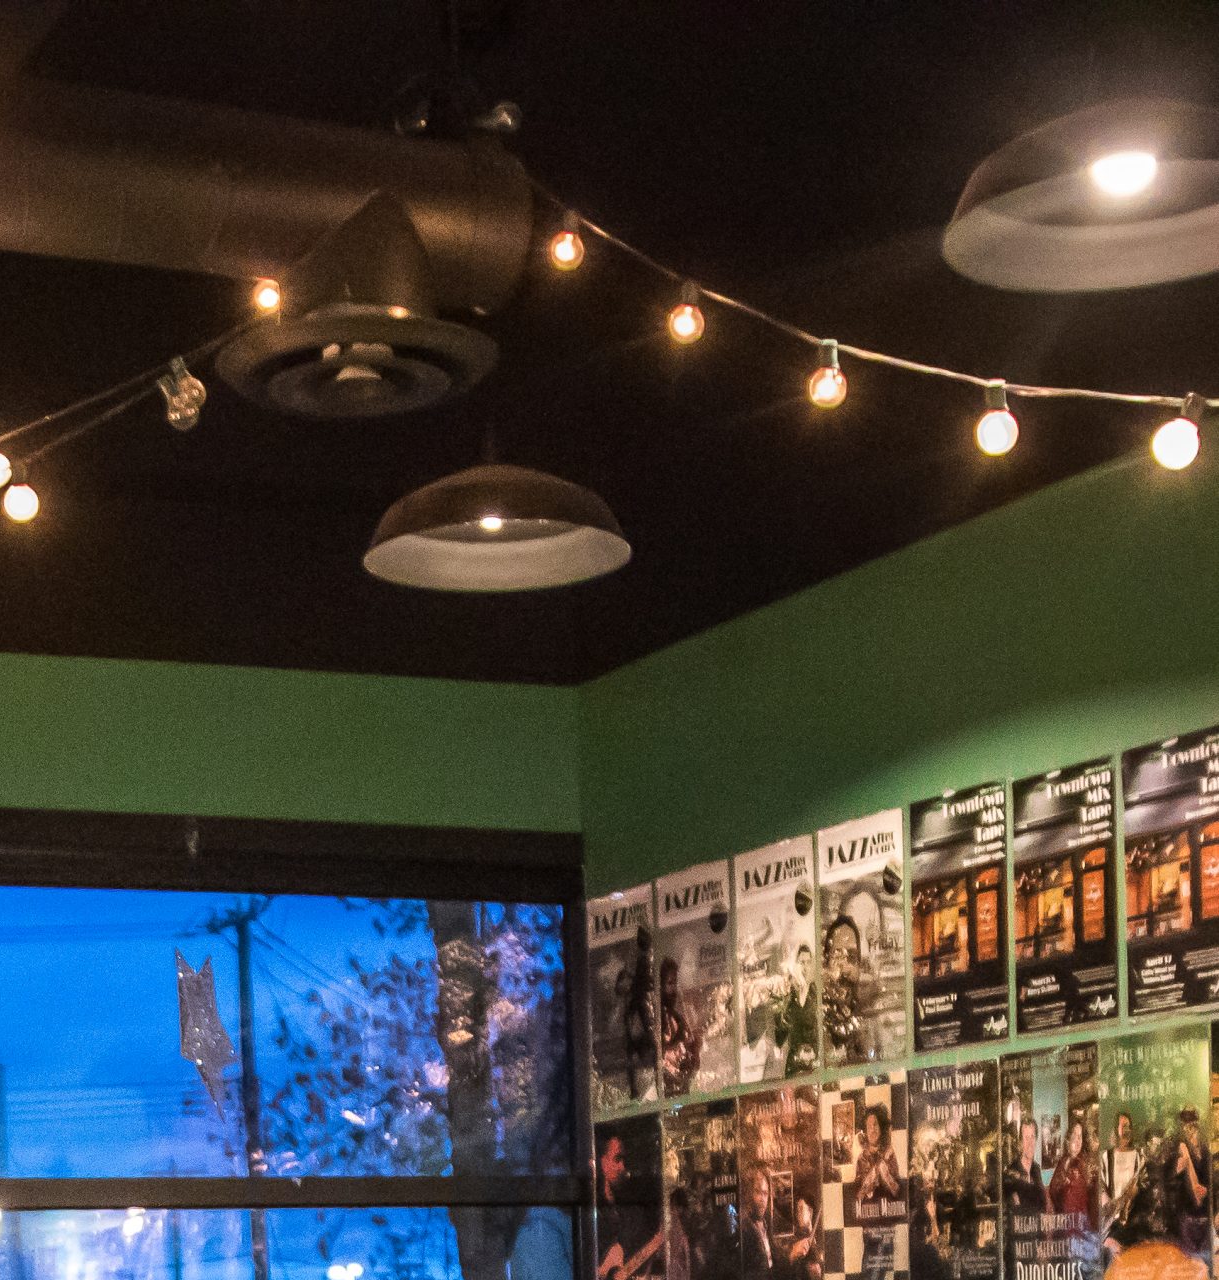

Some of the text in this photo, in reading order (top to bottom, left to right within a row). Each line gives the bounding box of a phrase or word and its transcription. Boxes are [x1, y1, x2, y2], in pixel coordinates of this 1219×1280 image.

[826, 837, 869, 868] JAZZ
[741, 861, 782, 892] JAZZ
[663, 885, 702, 914] JAZZ
[593, 904, 629, 934] JAZZ
